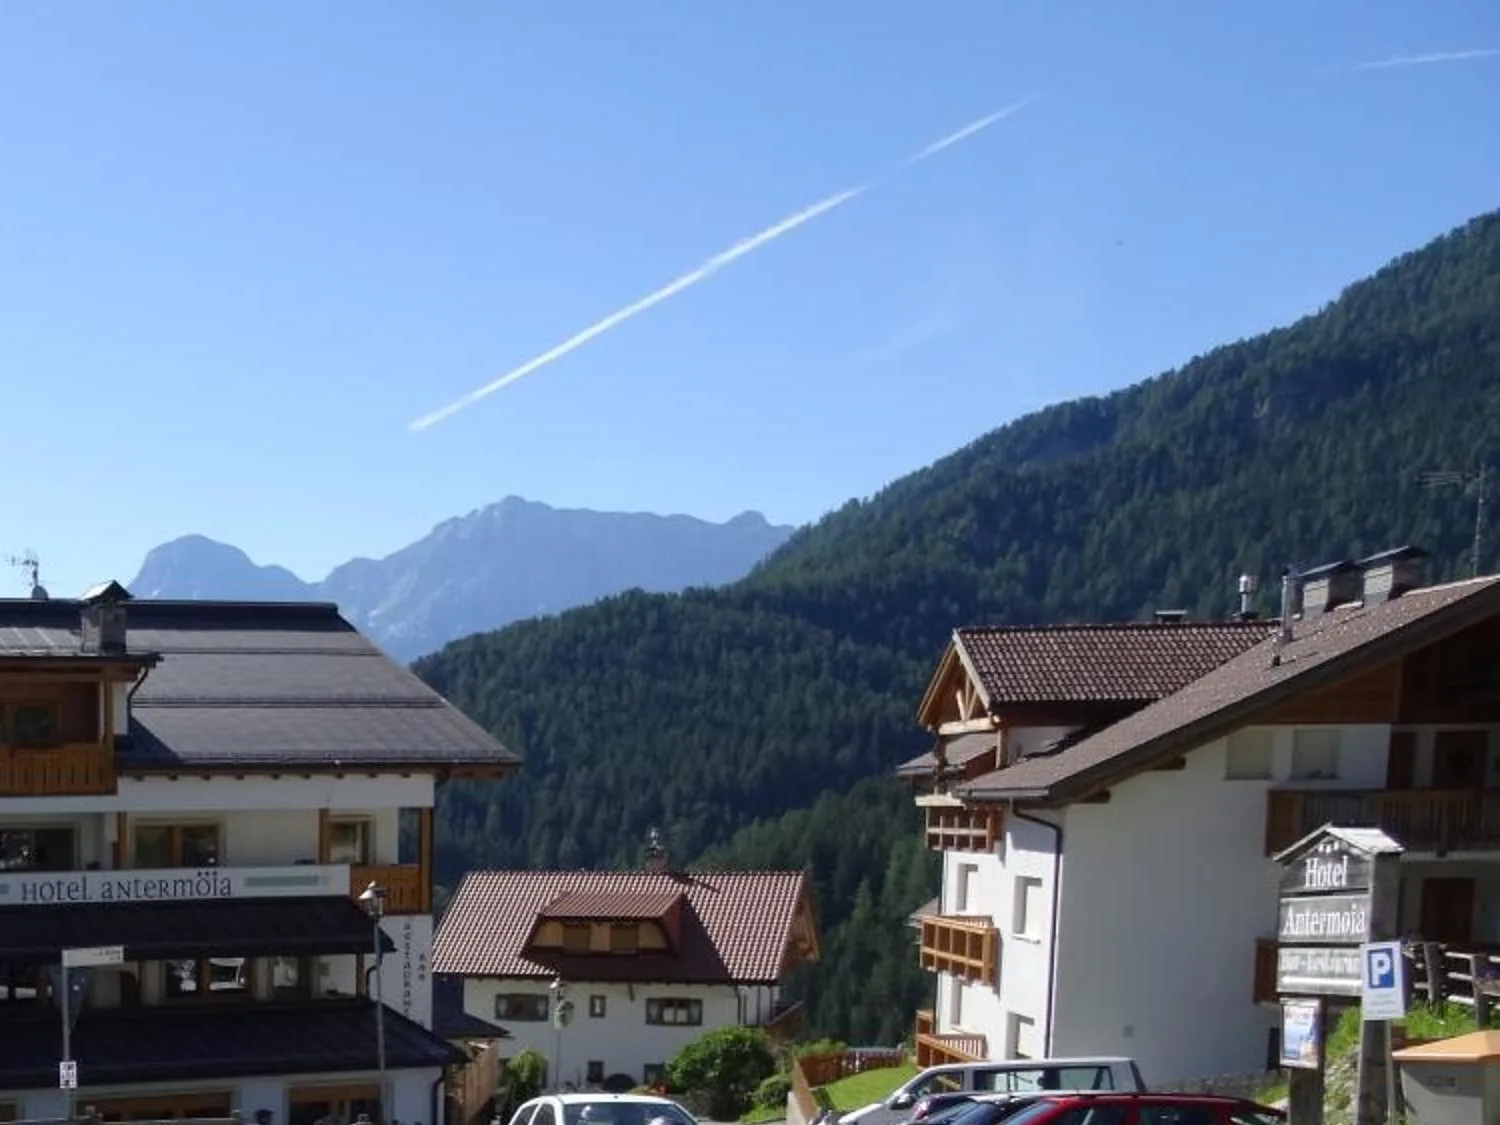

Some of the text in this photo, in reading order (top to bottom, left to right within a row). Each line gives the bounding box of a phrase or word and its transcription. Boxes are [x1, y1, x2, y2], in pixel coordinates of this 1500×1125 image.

[1304, 855, 1348, 888] Hotel
[1282, 904, 1366, 936] Antermoia
[1370, 952, 1391, 987] P
